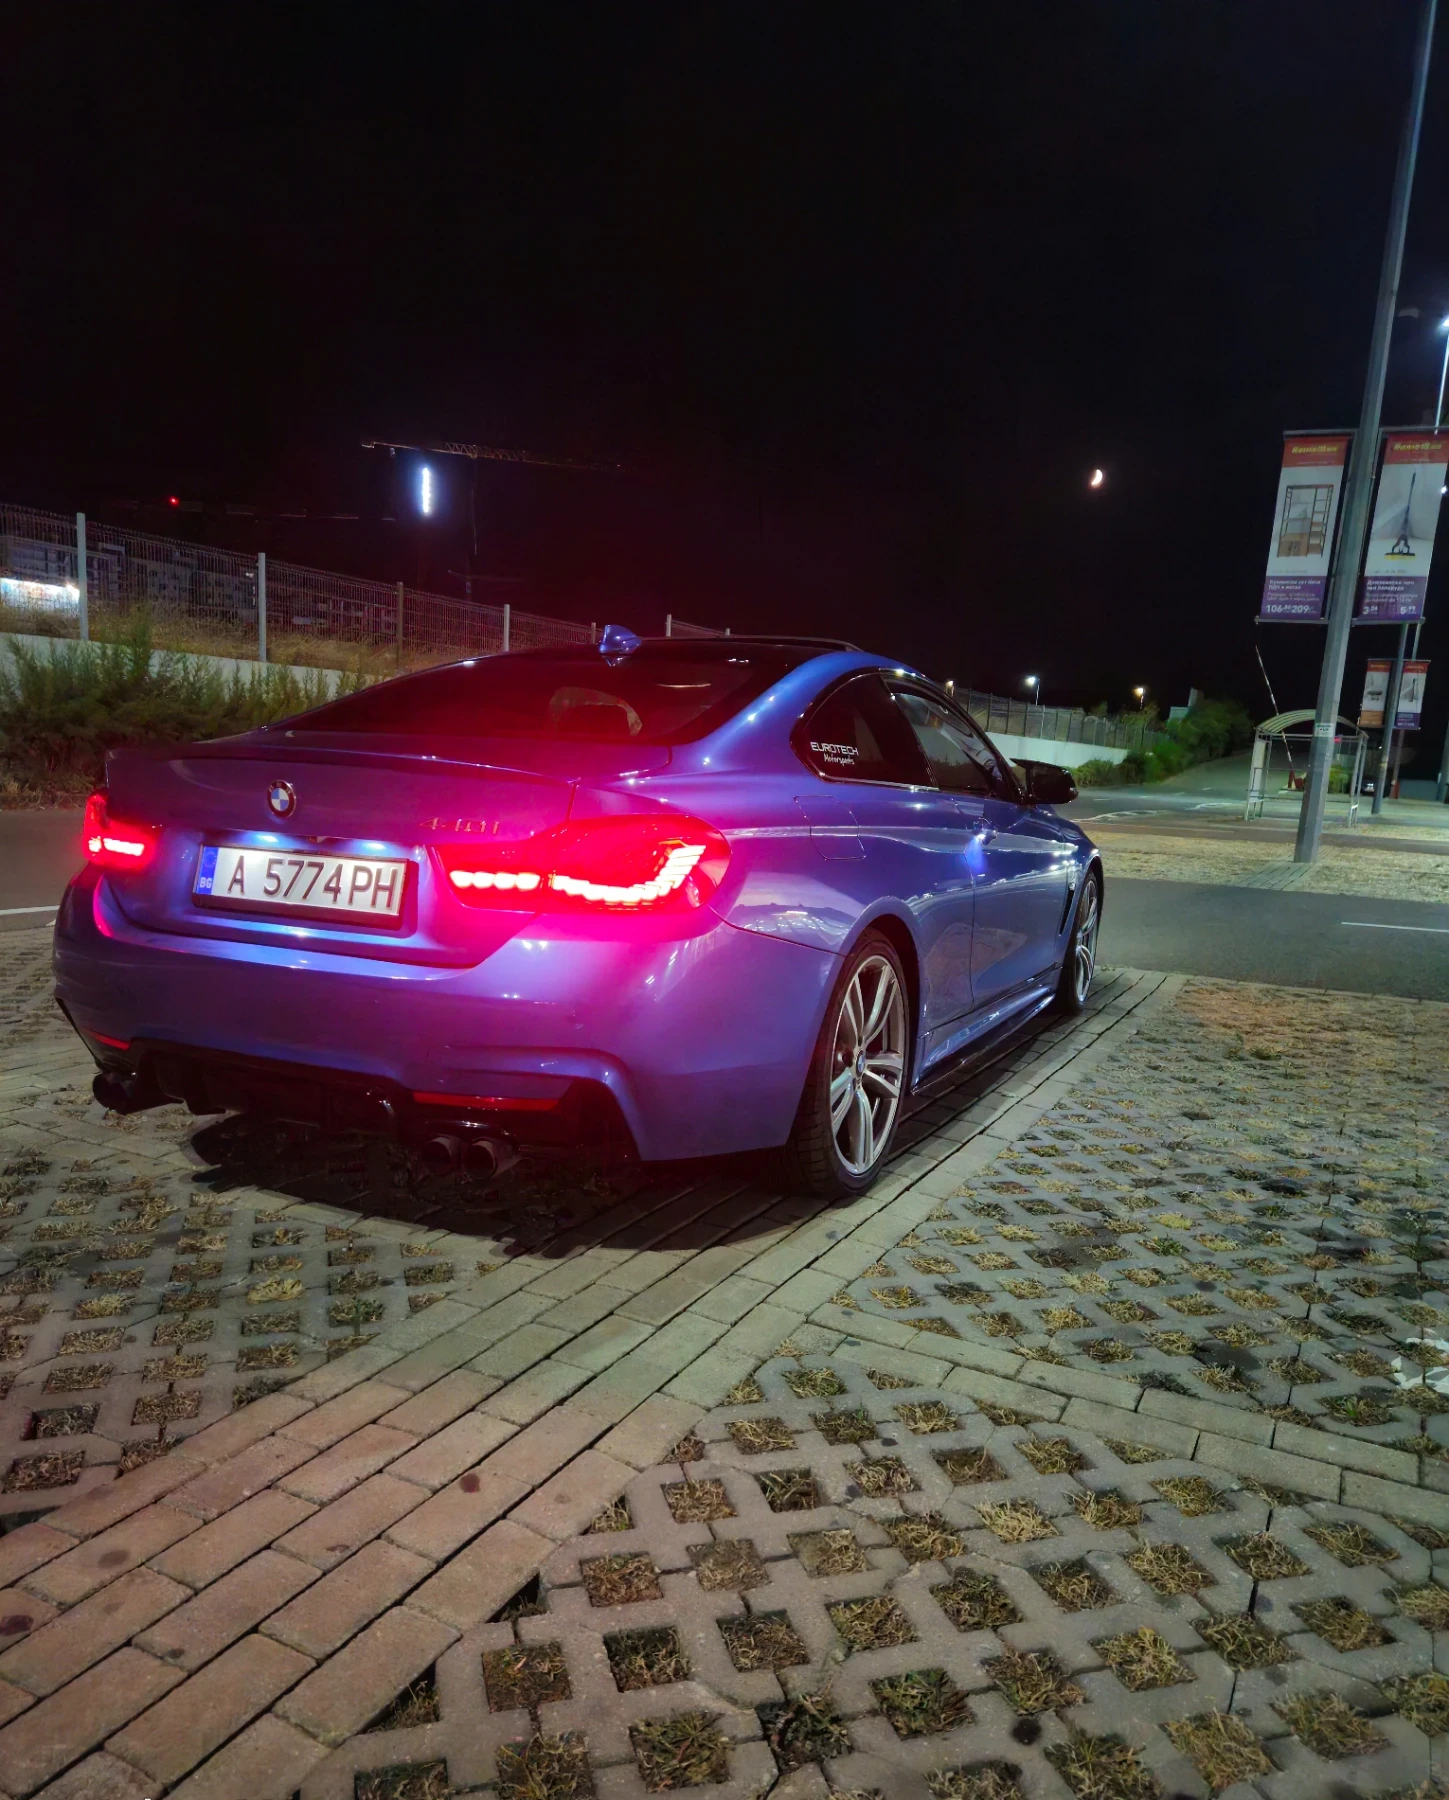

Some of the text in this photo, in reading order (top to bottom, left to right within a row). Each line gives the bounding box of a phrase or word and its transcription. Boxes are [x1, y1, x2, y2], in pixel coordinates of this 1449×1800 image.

[810, 741, 859, 756] EUROTECH
[227, 855, 245, 893] A
[199, 876, 213, 889] BG
